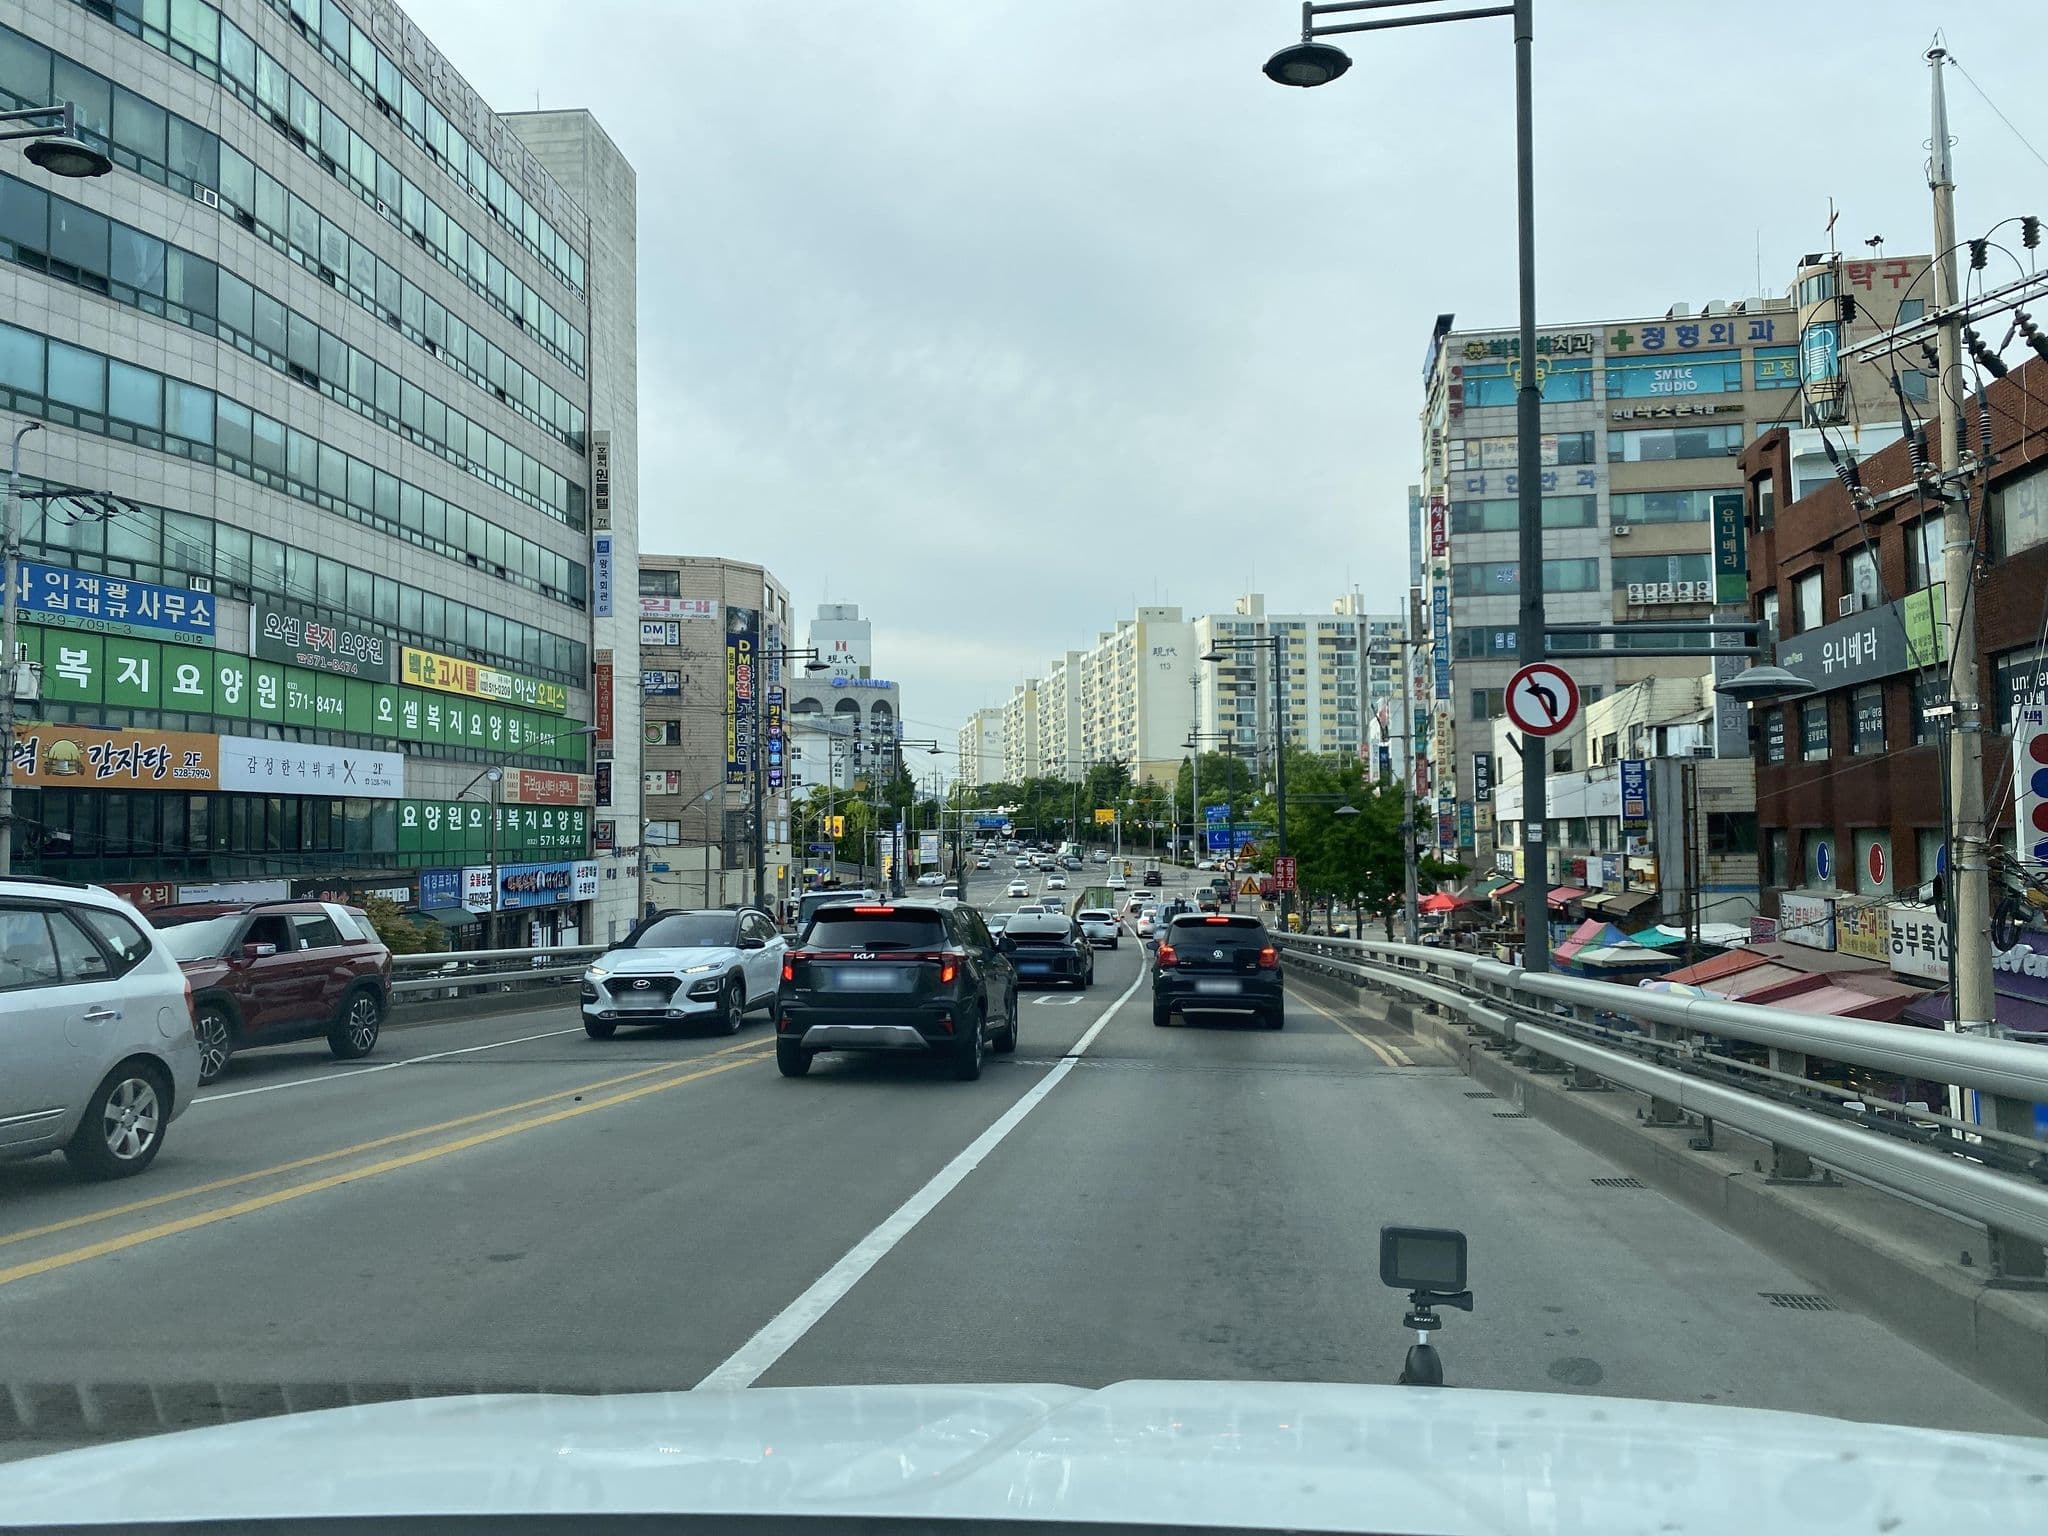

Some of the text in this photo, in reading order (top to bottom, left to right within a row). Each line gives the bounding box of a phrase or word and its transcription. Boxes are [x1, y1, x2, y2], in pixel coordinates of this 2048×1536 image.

[1847, 260, 1911, 291] 탁구
[1641, 319, 1775, 350] 정형외과
[1654, 368, 1692, 381] SMILE
[1761, 360, 1795, 377] 교정
[1651, 381, 1698, 393] STUDIO
[1723, 508, 1737, 567] 유니베라
[44, 571, 129, 600] 이재광
[44, 593, 129, 619] 심대규
[137, 590, 211, 627] 사무소
[639, 599, 710, 613] 임대
[264, 613, 384, 665] 오셀 복지 요양원
[643, 624, 663, 634] DM
[827, 654, 857, 664] 現代
[1822, 627, 1878, 675] 유니베라
[55, 647, 277, 709] 복지요양원
[289, 692, 343, 715] 571-8474
[377, 698, 519, 744] 오셀복지요양원
[87, 740, 172, 780] 감자탕
[184, 752, 201, 766] 2F
[173, 768, 211, 779] 528-7994
[1624, 763, 1643, 798] 부동산
[540, 834, 581, 846] 571-8474
[853, 952, 876, 960] KIA
